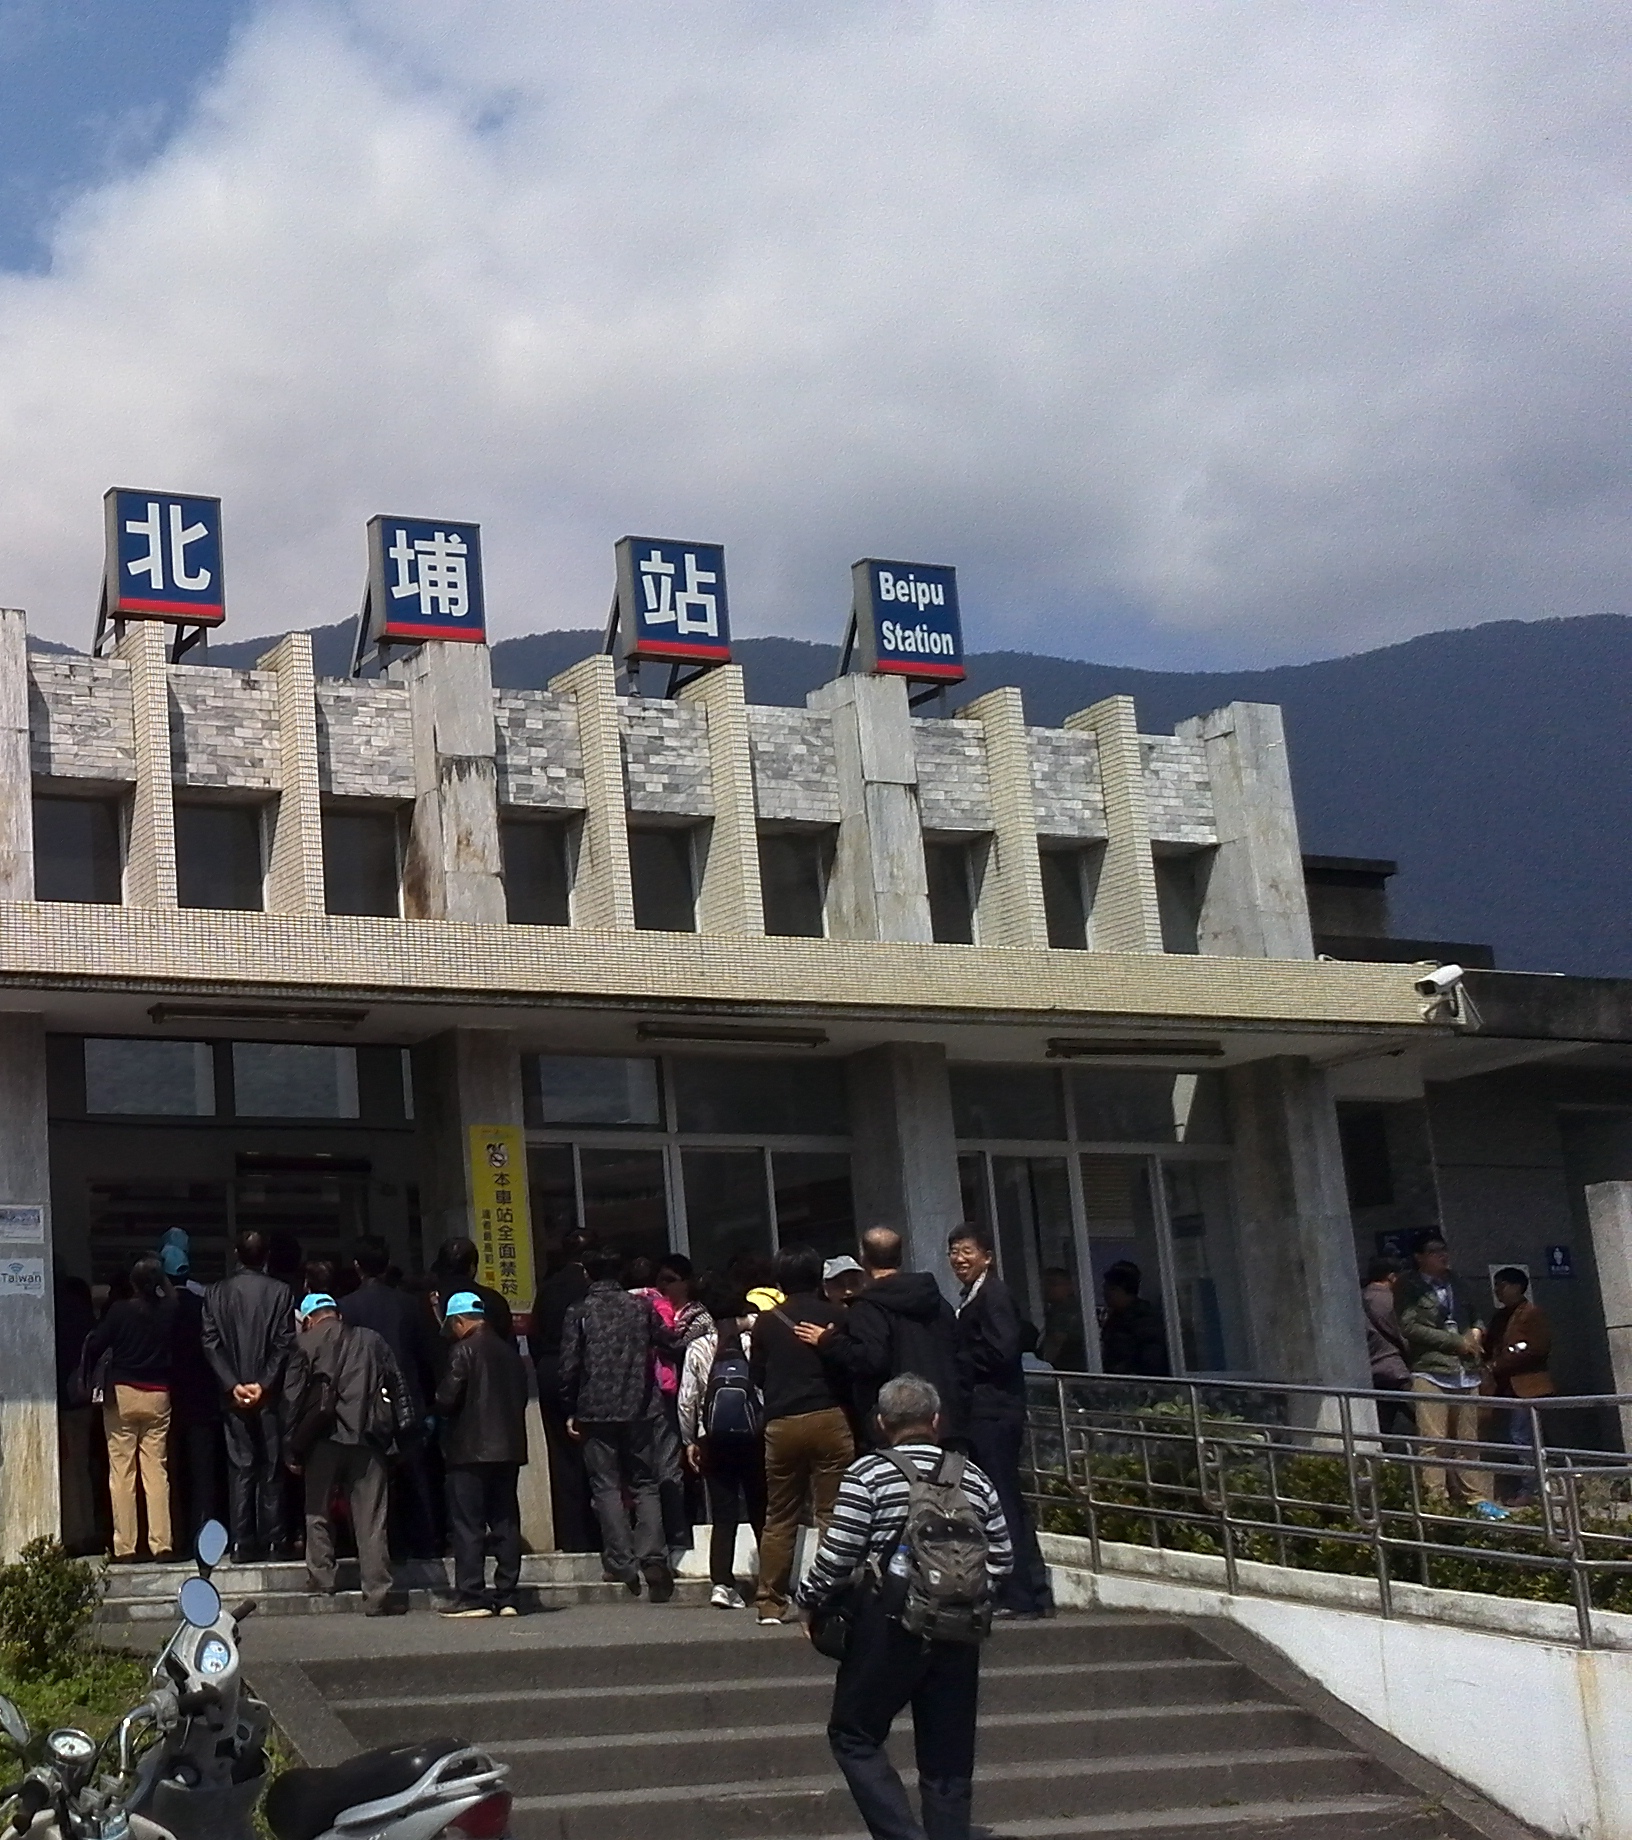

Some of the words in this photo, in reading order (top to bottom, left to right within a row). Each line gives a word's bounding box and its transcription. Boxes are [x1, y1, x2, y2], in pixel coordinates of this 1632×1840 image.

[125, 502, 211, 590] 北
[389, 528, 469, 617] 埔
[639, 550, 719, 637] 站
[878, 570, 945, 611] Beipu
[881, 620, 954, 656] Station
